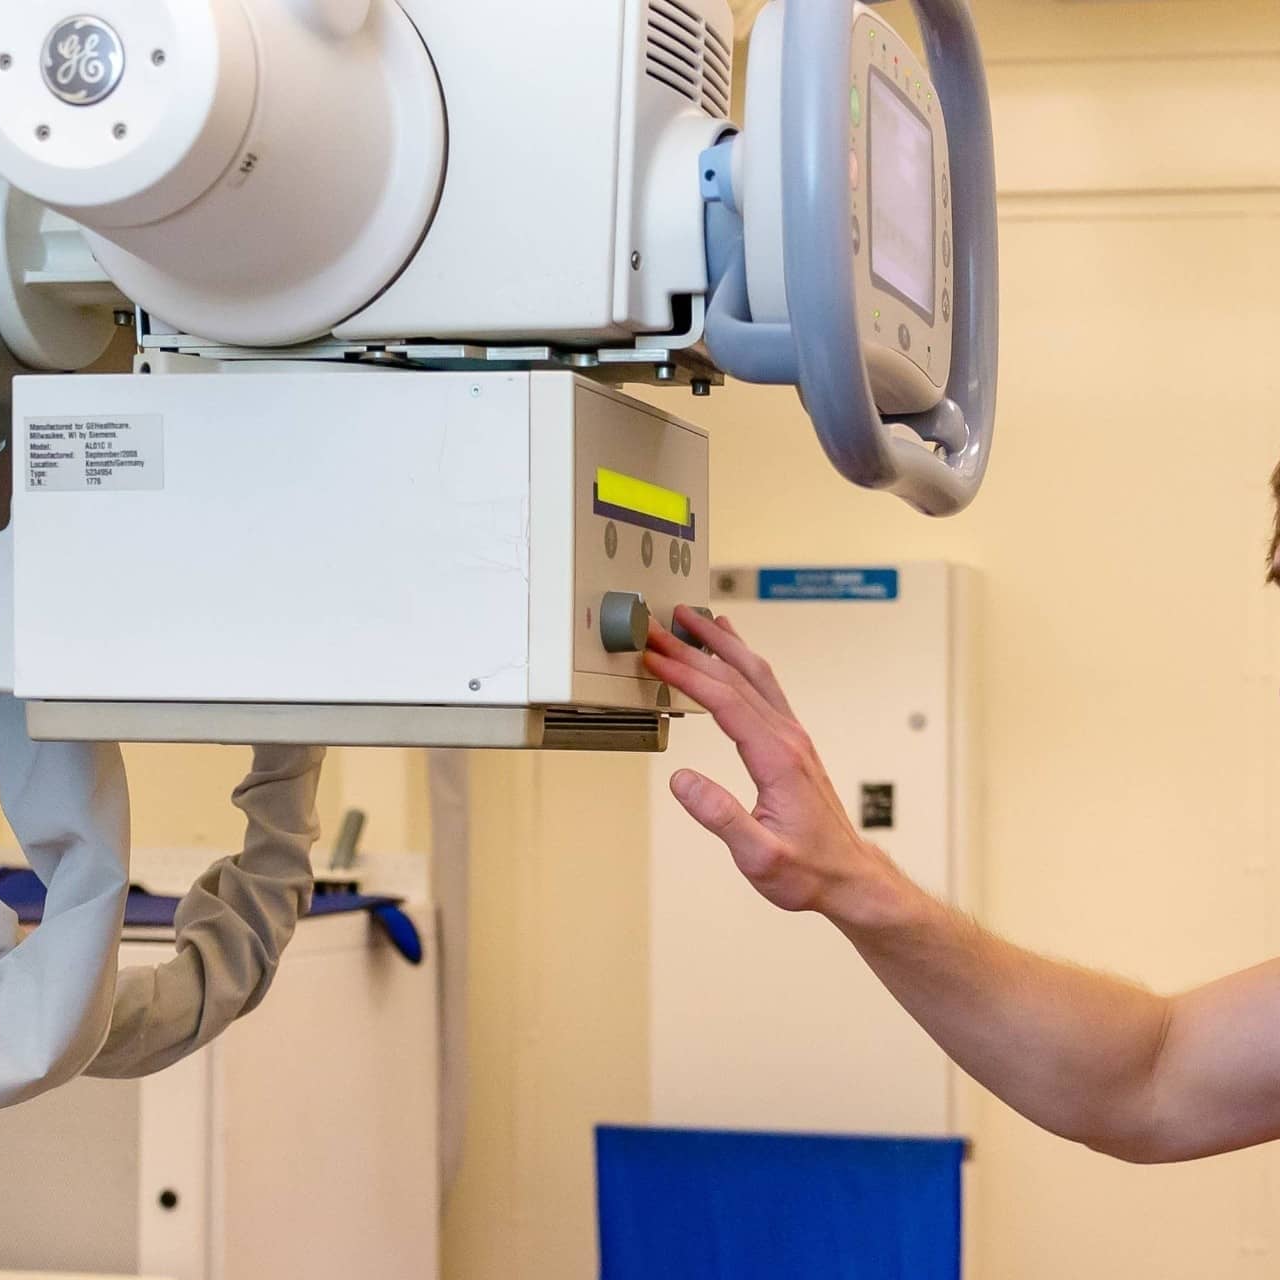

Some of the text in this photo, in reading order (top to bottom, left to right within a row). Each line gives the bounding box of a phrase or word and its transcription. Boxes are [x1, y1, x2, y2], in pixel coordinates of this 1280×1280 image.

[29, 423, 72, 431] Manufactured
[68, 431, 77, 439] WI
[79, 431, 86, 440] by
